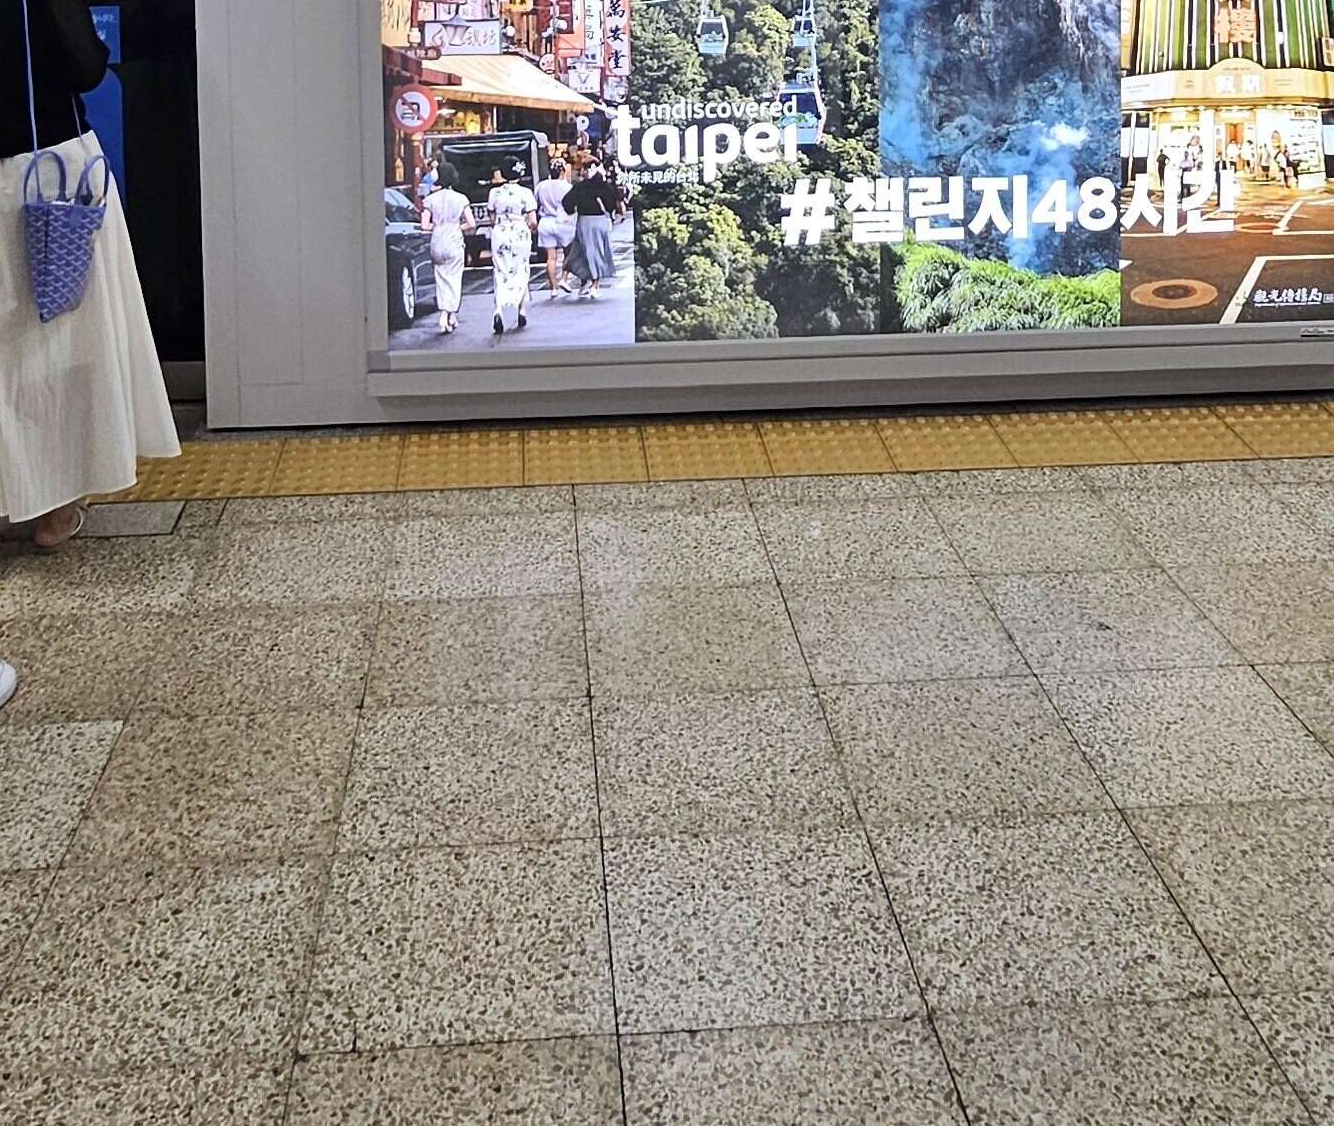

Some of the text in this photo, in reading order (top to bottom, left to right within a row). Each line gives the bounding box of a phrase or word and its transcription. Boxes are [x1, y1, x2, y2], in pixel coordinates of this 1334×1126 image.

[611, 104, 798, 183] taipei
[641, 94, 797, 121] undiscovered
[780, 167, 1241, 246] #챌린지48시간
